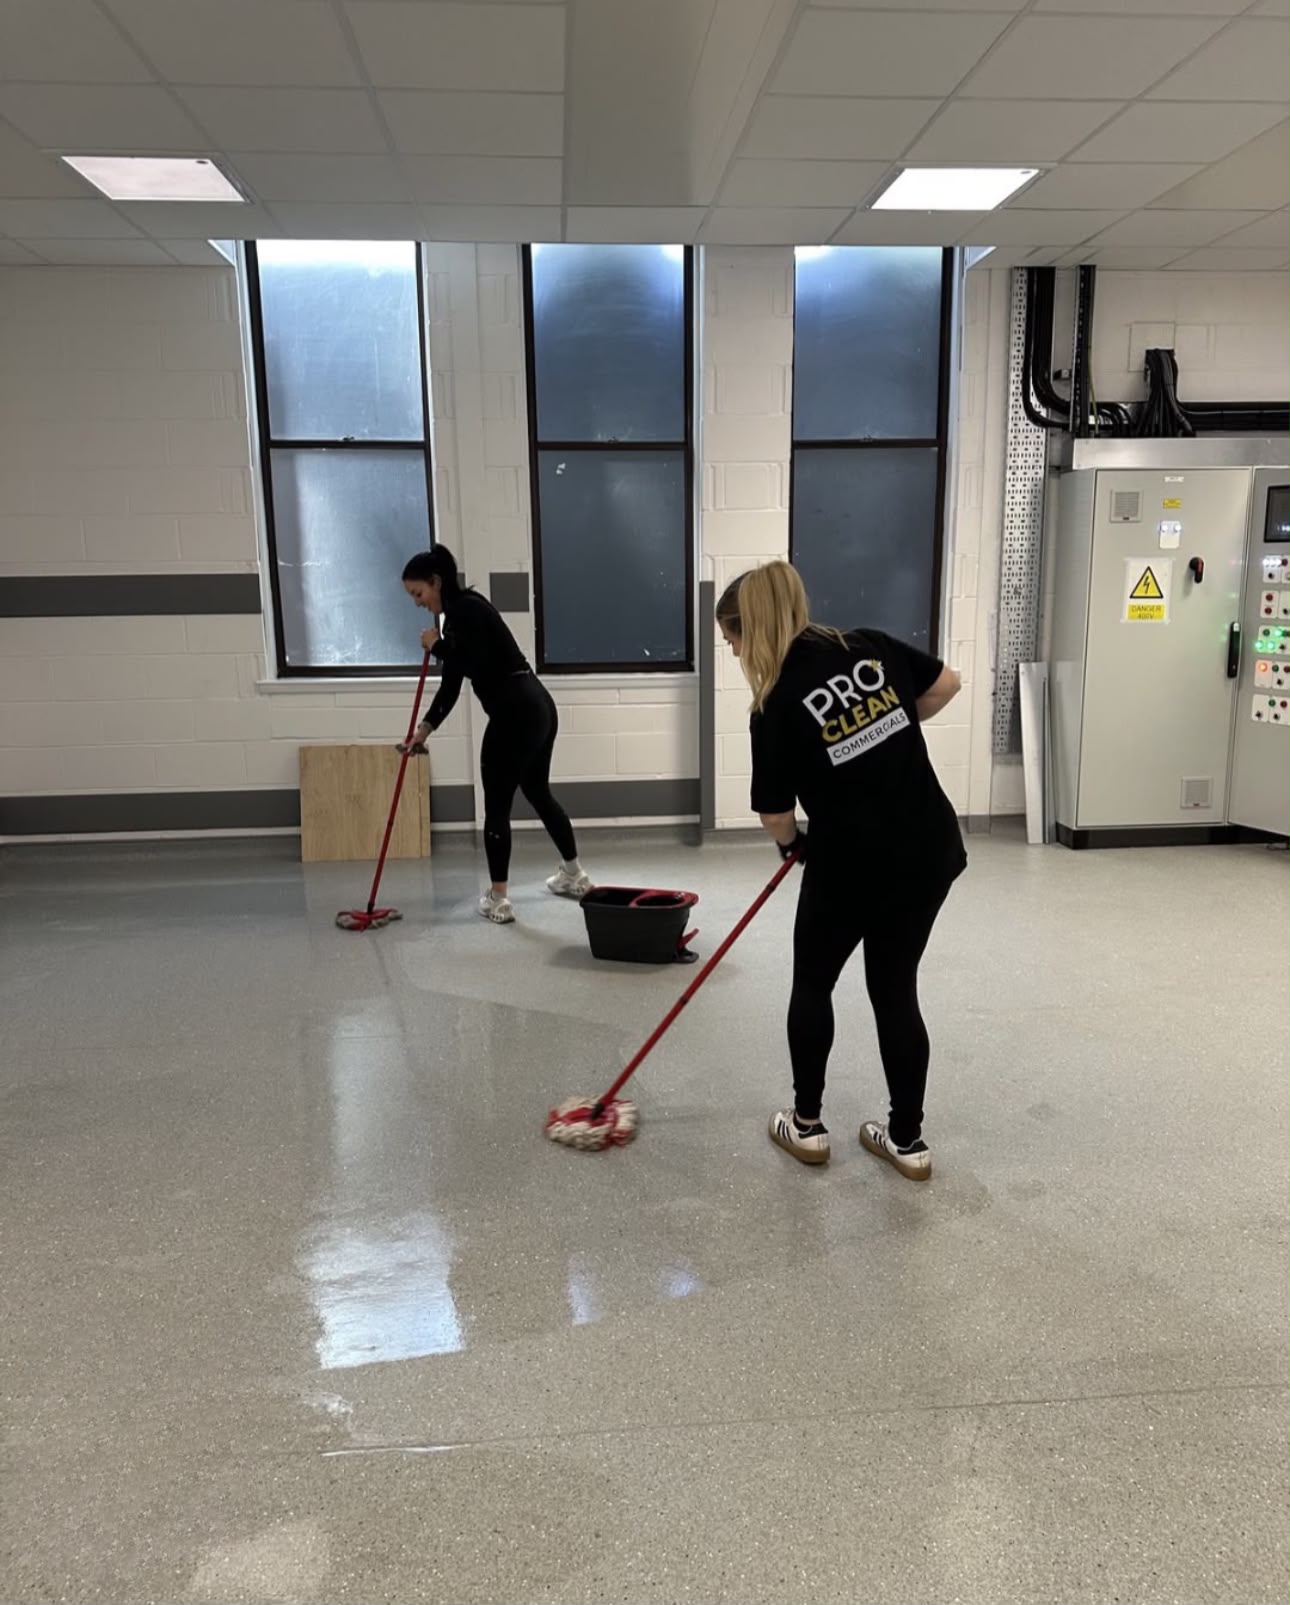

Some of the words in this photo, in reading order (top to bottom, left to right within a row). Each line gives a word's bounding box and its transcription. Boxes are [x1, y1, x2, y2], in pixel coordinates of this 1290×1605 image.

[1131, 604, 1162, 613] DANGER
[802, 659, 885, 727] PRO
[822, 686, 900, 743] CLEAN
